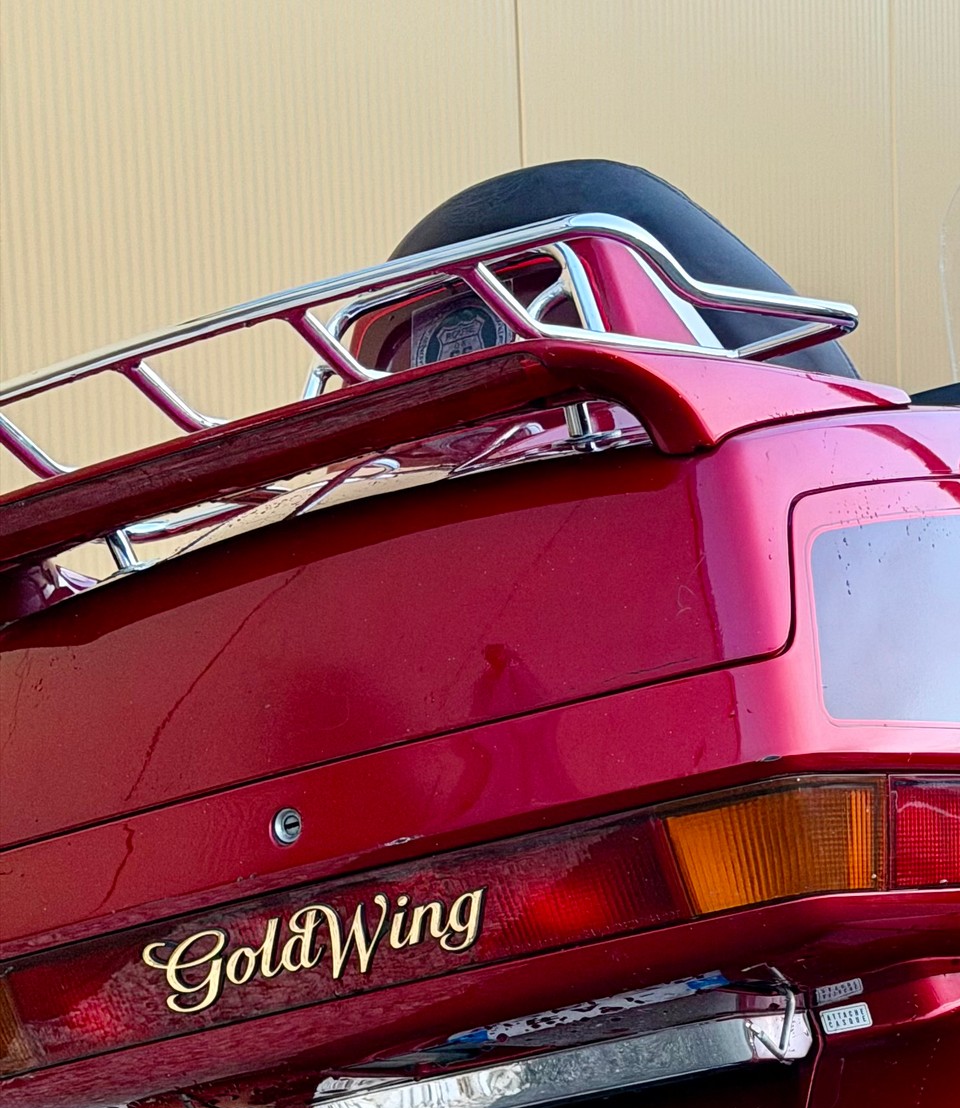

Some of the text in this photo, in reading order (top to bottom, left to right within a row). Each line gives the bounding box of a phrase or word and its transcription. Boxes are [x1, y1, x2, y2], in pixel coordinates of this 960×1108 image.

[142, 888, 486, 1013] GoldWing
[826, 1008, 864, 1021] ATTACHE
[828, 1016, 867, 1028] CASQUE
